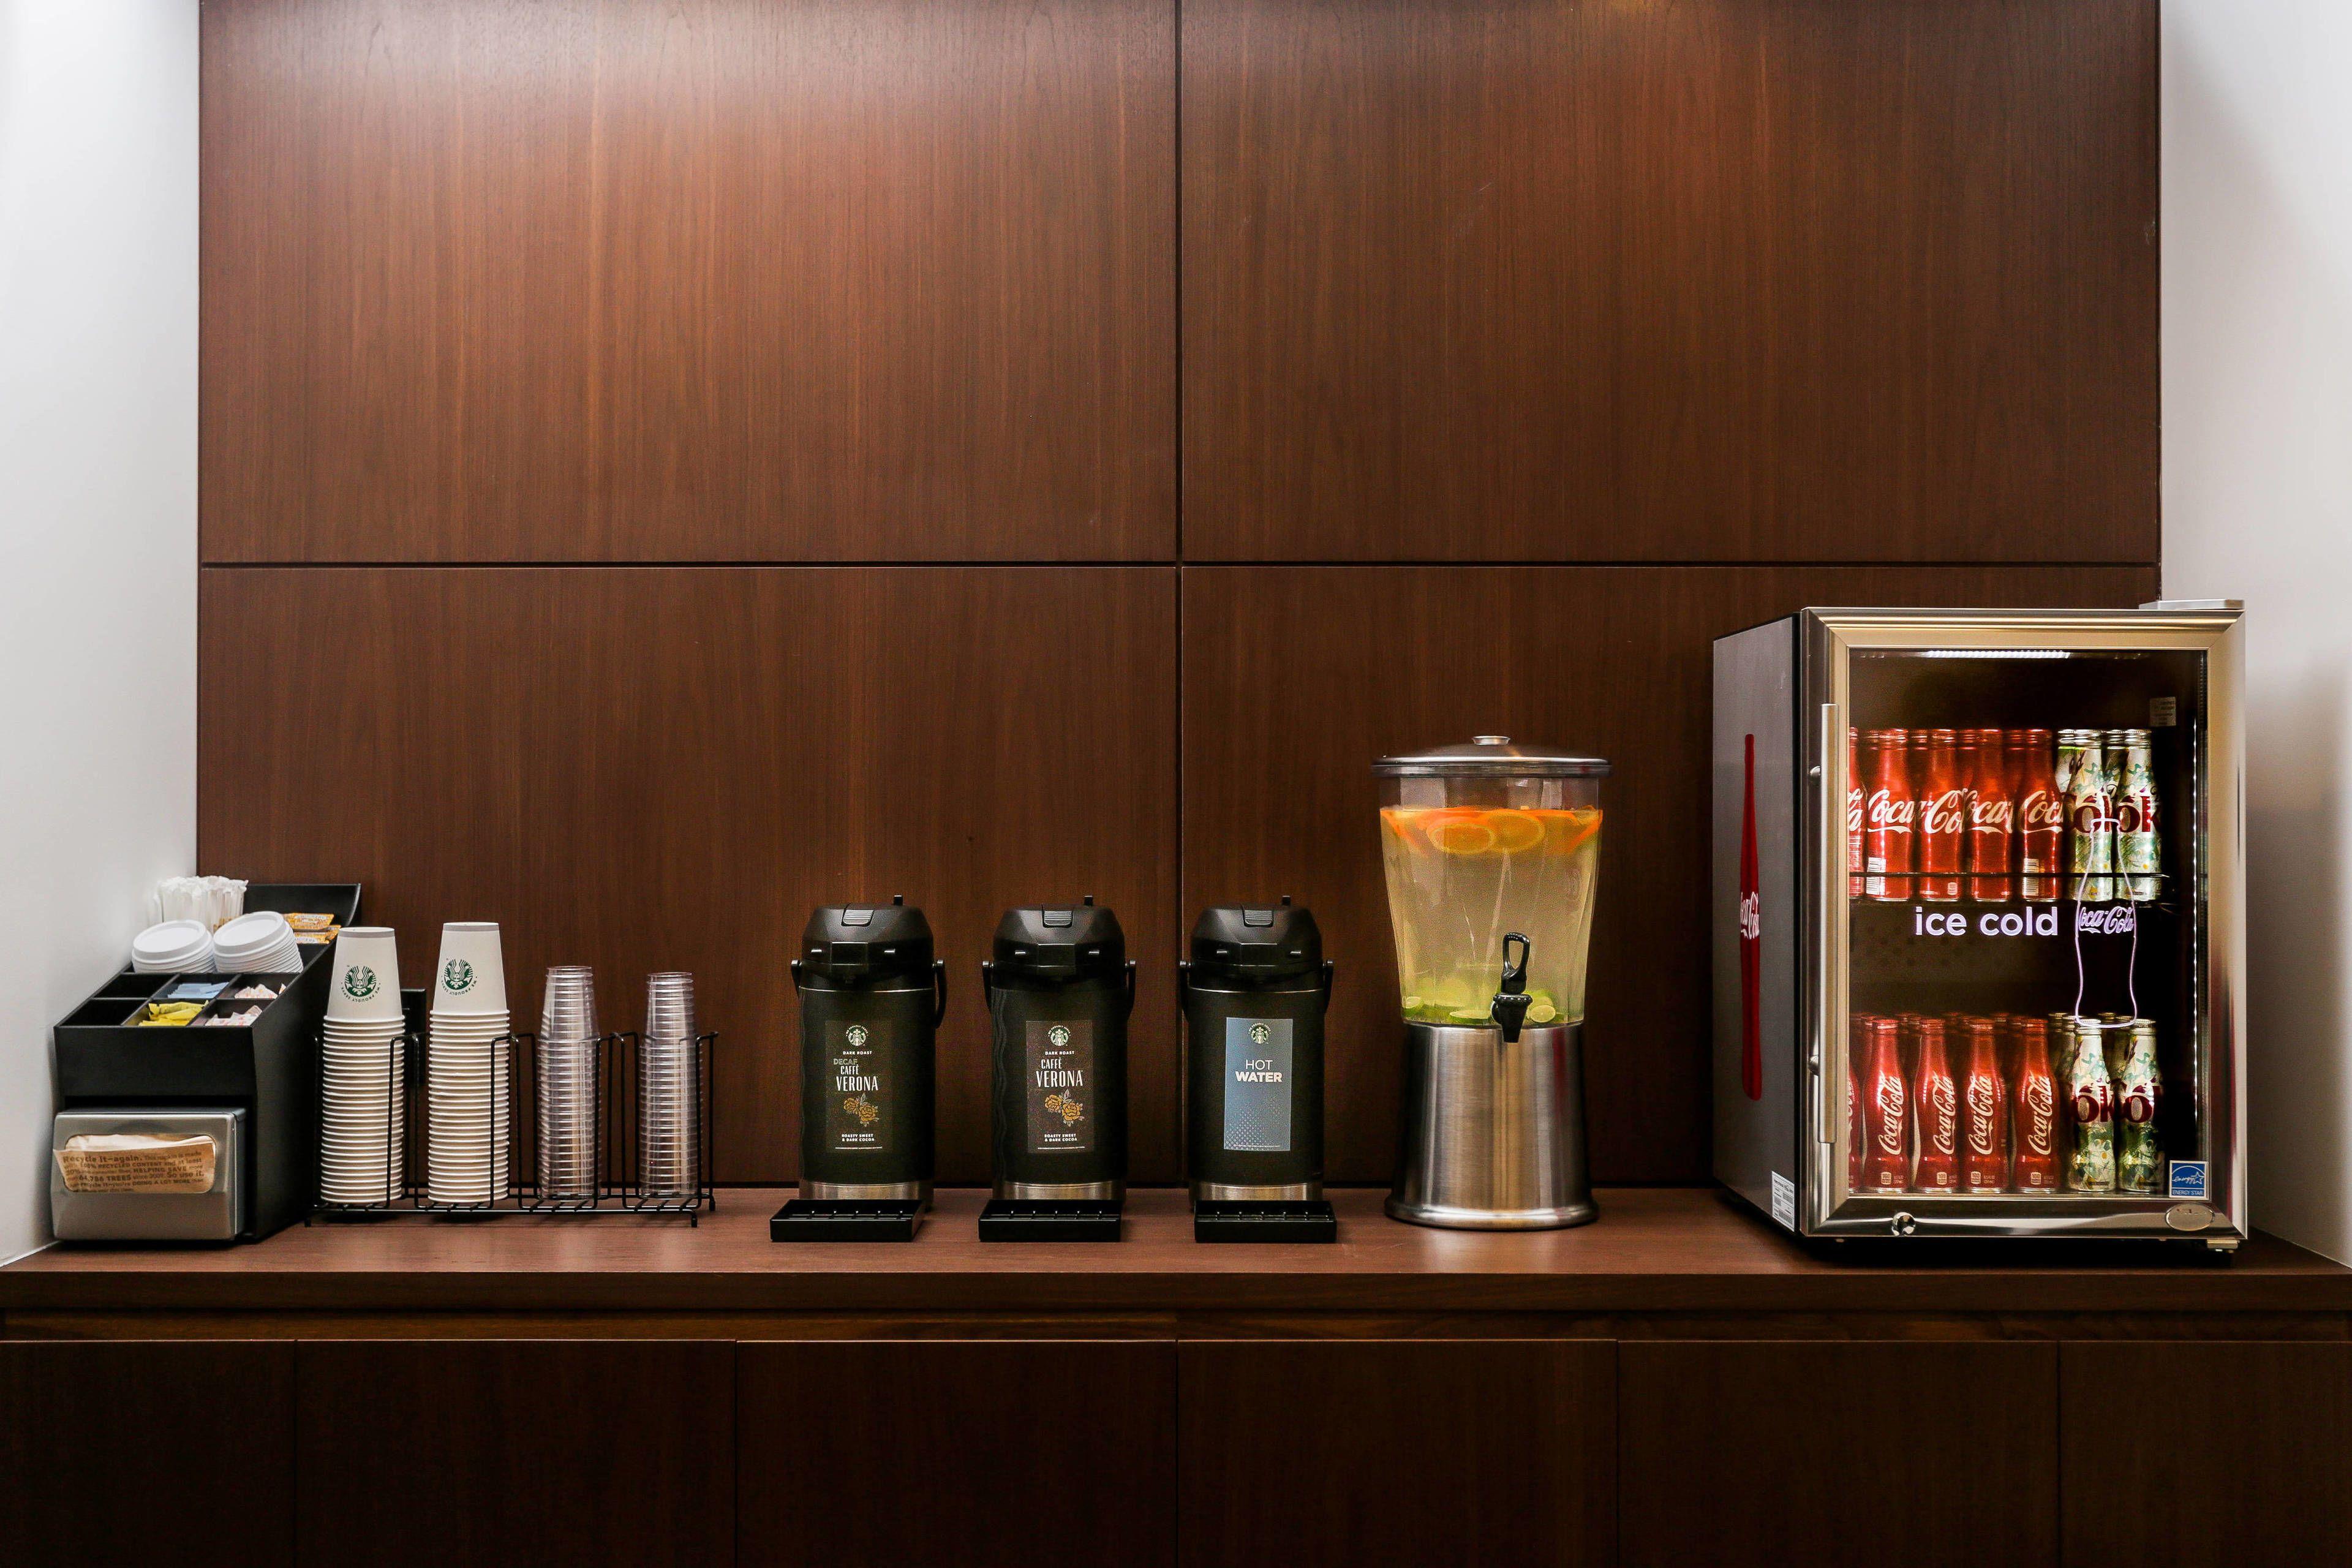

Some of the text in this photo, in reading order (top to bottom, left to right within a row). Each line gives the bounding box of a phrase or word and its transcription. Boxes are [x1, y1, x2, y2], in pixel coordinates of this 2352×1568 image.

[1915, 906, 2058, 935] ice cold
[2079, 906, 2134, 935] Coca-Cola
[840, 1064, 859, 1075] CAFFÈ
[1041, 1057, 1063, 1069] CAFFÈ
[1245, 1060, 1273, 1070] HOT
[836, 1076, 878, 1091] VERONA
[1036, 1070, 1083, 1088] VERONA
[1235, 1071, 1283, 1082] WATER
[1878, 1070, 1904, 1155] Coca-Cola
[1932, 1070, 1956, 1155] Coca-Cola
[1967, 1071, 1994, 1155] Coca-Cola
[2027, 1070, 2053, 1156] Coca-Cola
